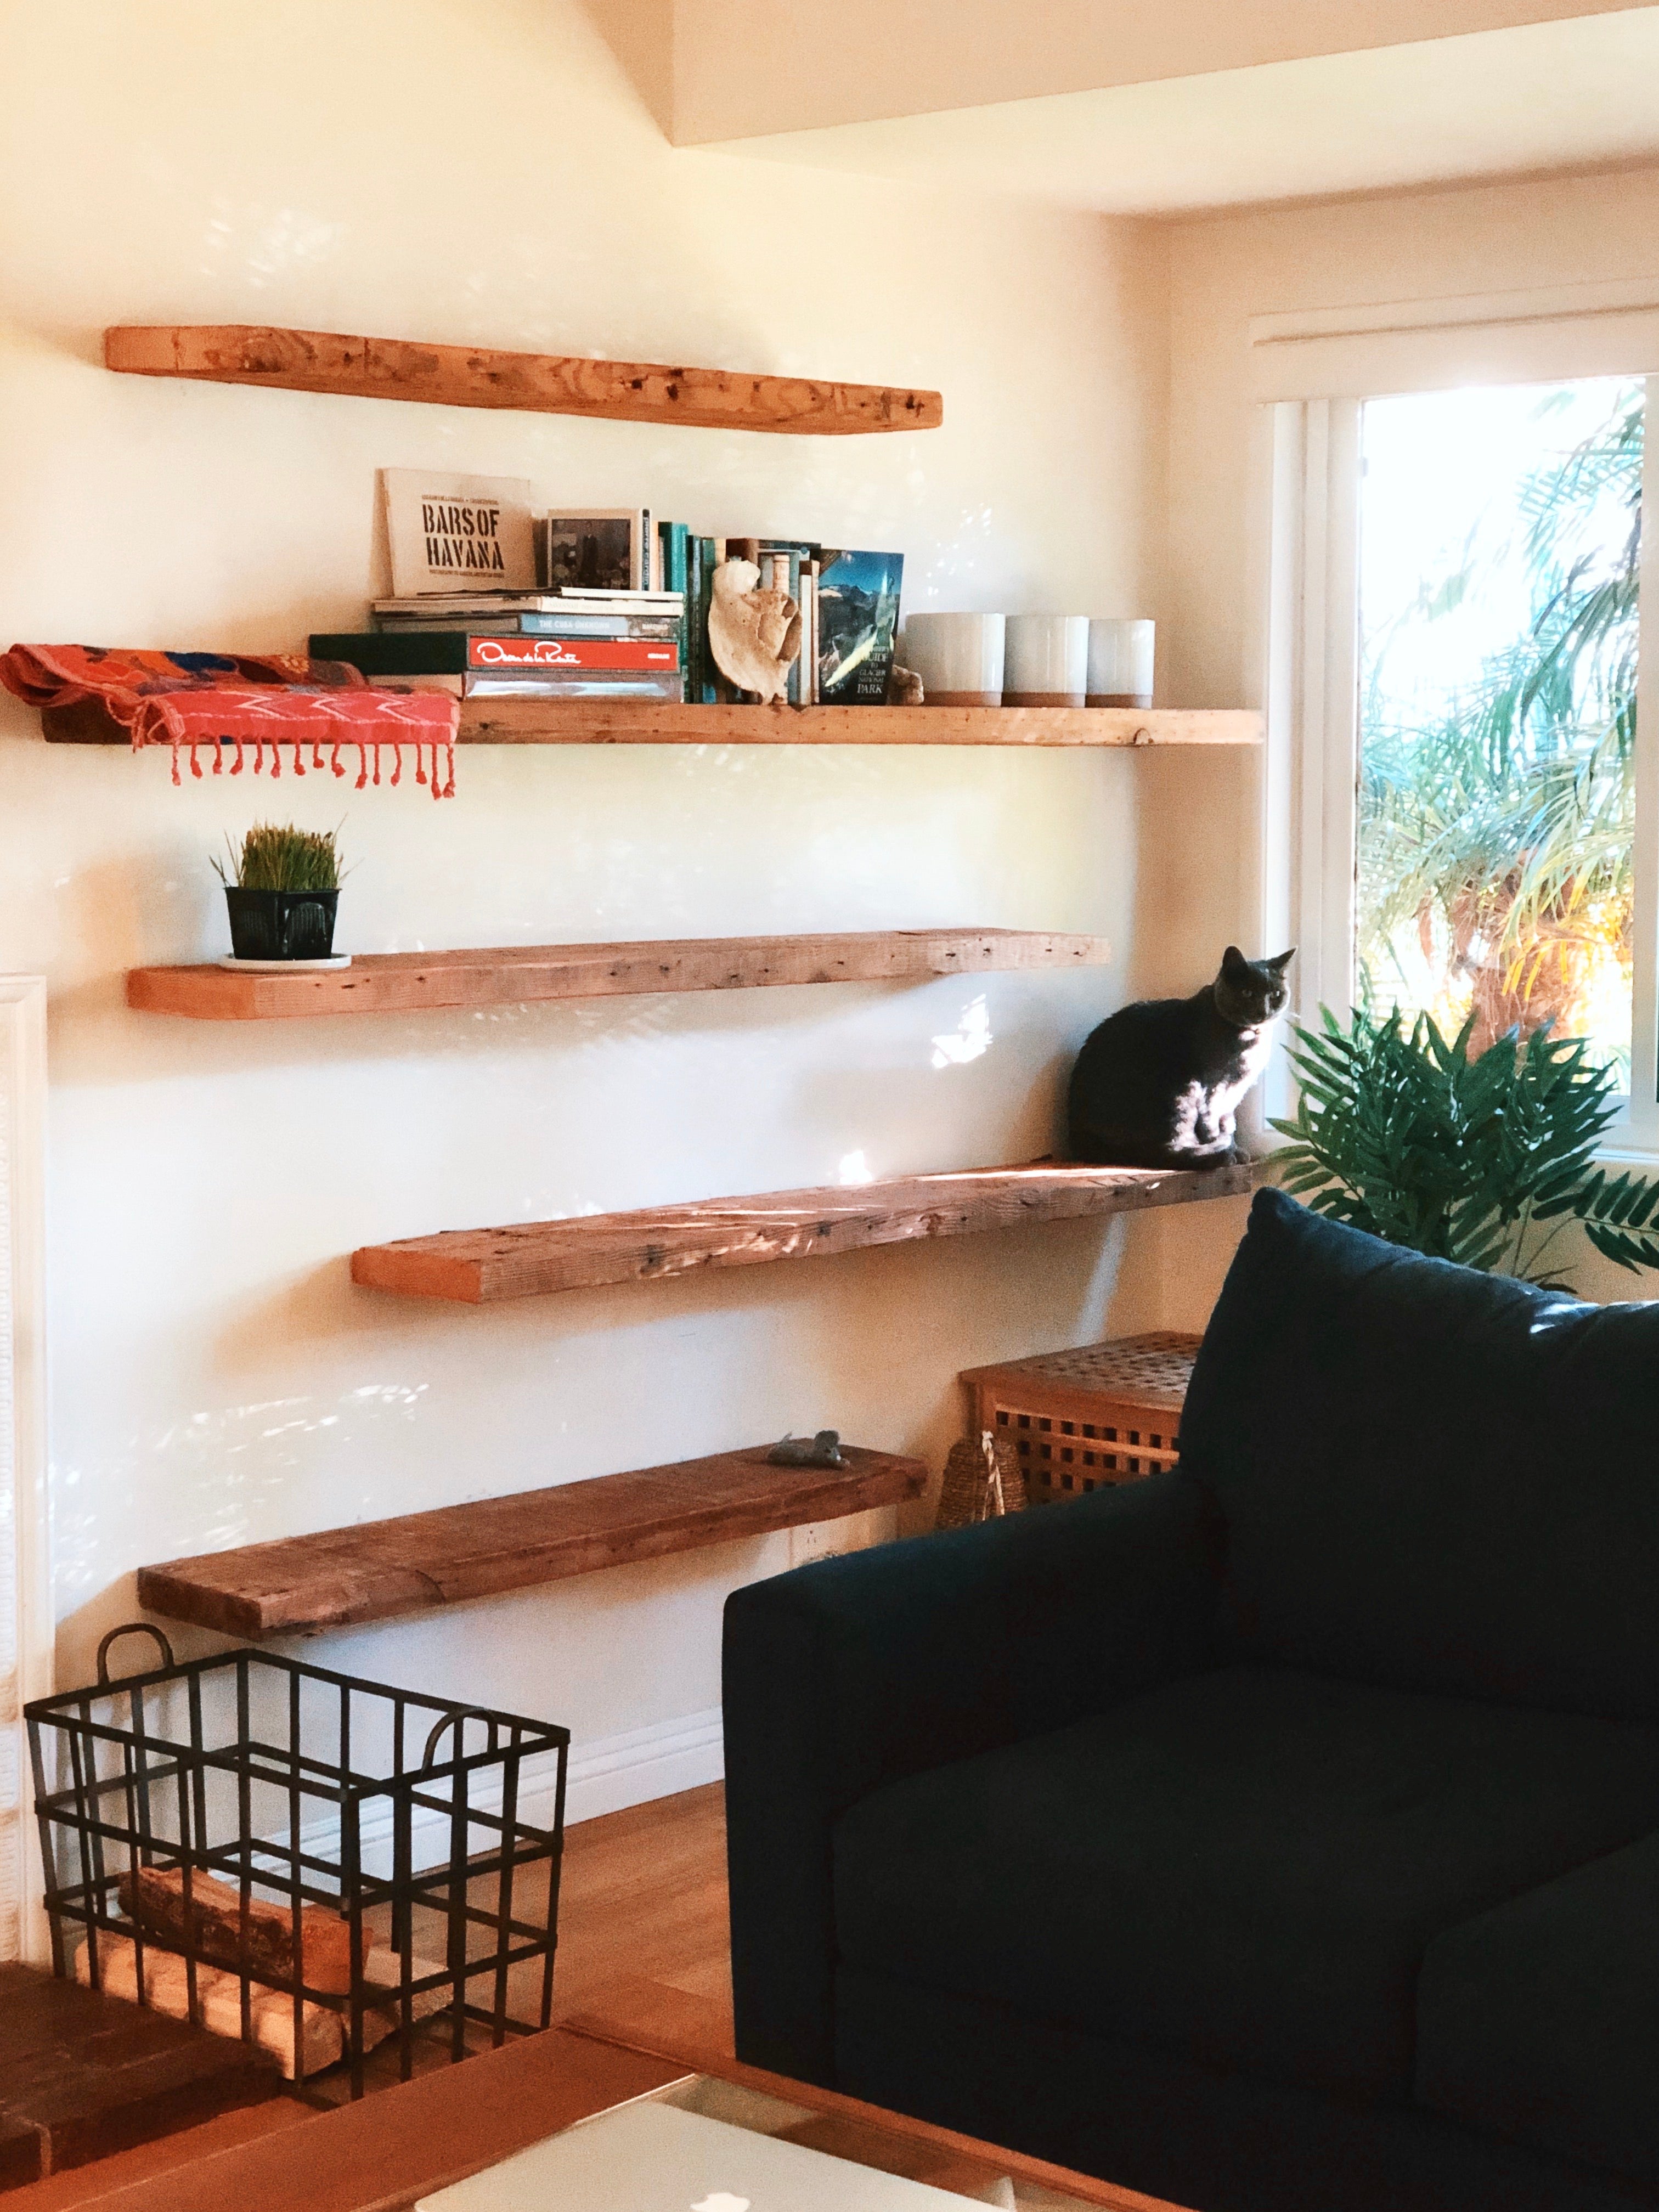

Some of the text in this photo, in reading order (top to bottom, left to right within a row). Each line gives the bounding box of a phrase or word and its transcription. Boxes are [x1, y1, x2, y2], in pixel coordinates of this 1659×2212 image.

[422, 504, 500, 537] BARS OF
[426, 537, 504, 570] HAVANA
[539, 619, 552, 628] THE
[857, 684, 882, 693] PARK
